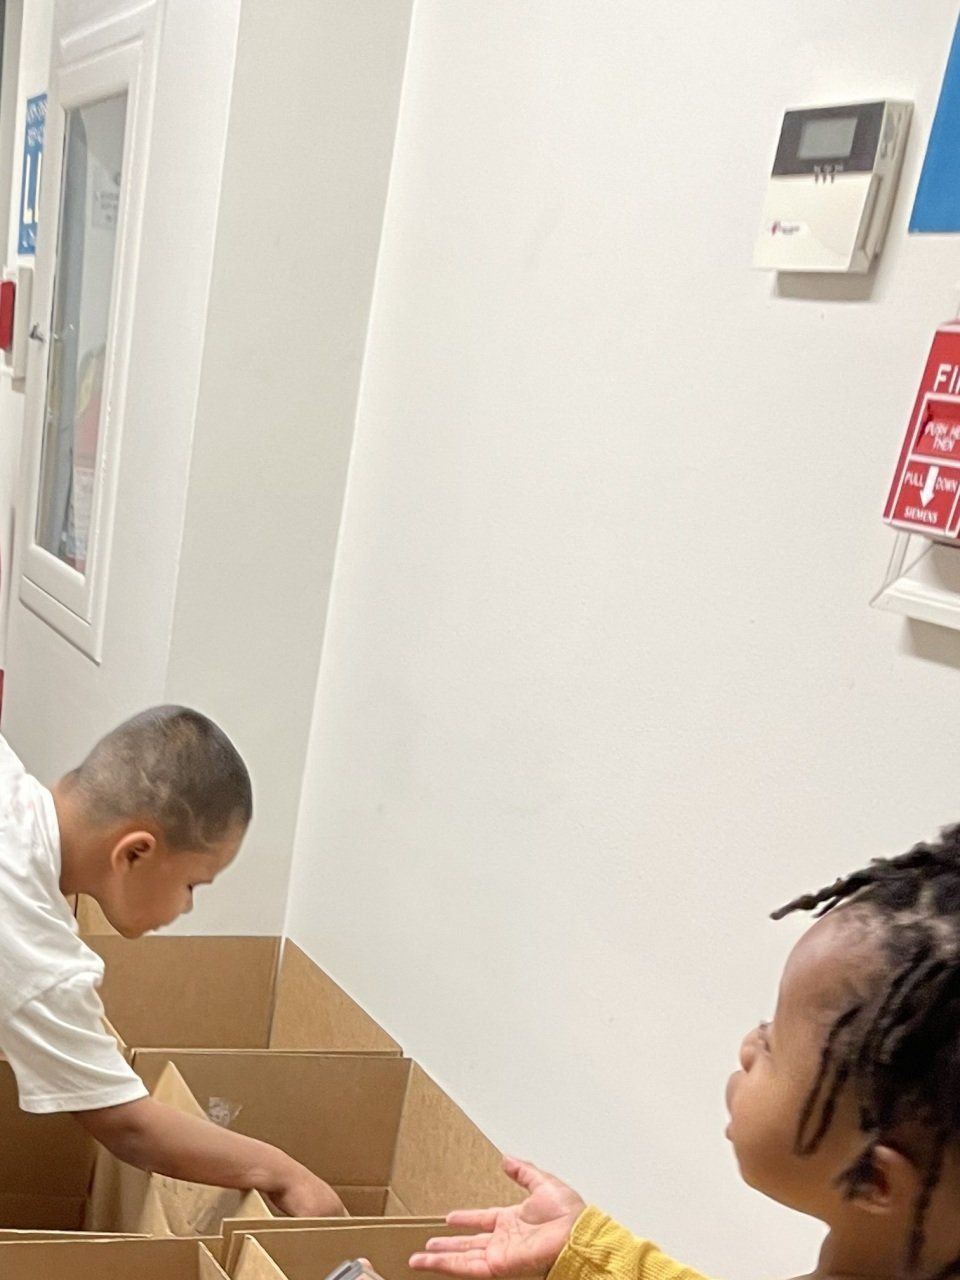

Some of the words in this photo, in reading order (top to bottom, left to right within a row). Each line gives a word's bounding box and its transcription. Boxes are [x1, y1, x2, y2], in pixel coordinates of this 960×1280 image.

[904, 471, 923, 487] PULL
[936, 476, 958, 493] DOWN
[904, 506, 938, 524] SIEMENS
